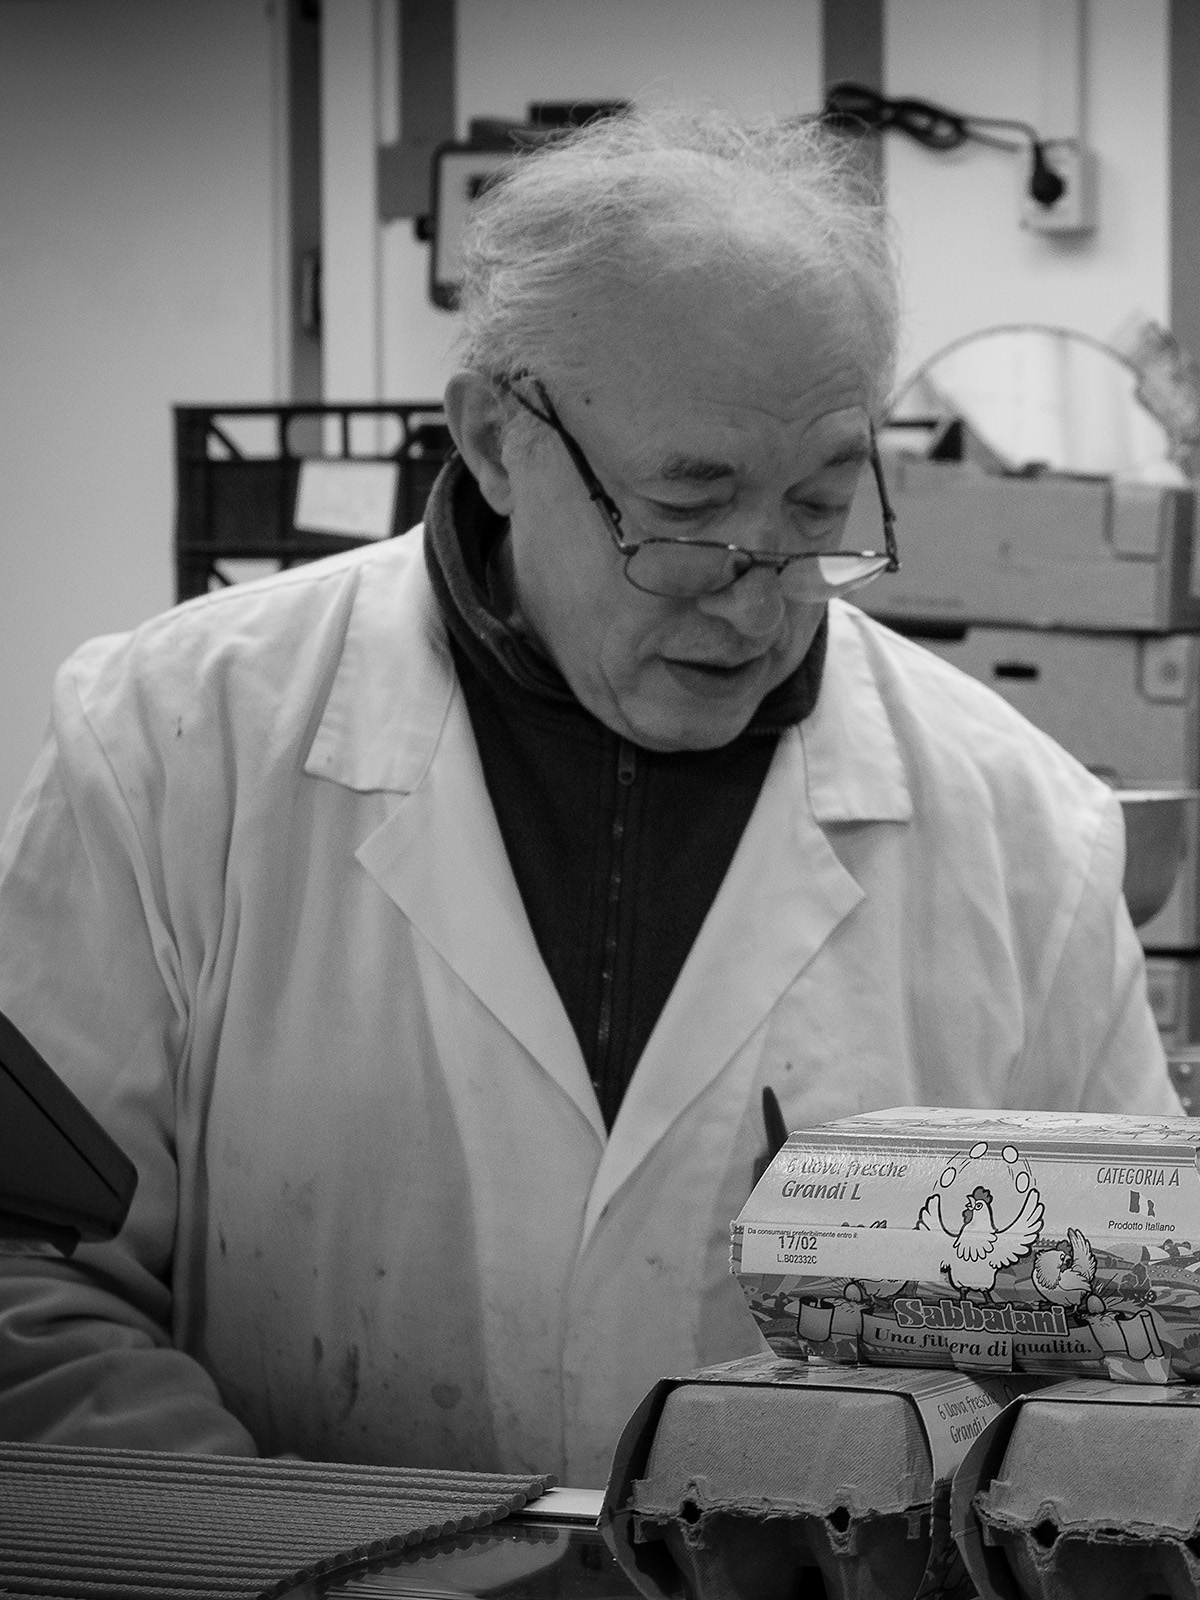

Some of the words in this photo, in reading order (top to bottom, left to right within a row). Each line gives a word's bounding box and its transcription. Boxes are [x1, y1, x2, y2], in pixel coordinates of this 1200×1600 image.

[786, 1158, 796, 1174] 6
[845, 1160, 908, 1178] fresche
[1096, 1167, 1164, 1186] CATEGORIA
[1168, 1168, 1180, 1187] A
[781, 1180, 849, 1200] Grandi
[851, 1183, 862, 1200] L
[747, 1227, 757, 1235] Da
[757, 1228, 792, 1237] consumarsi
[1108, 1220, 1143, 1231] Prodotto
[1145, 1222, 1176, 1232] Italiano
[778, 1235, 818, 1251] 17/02
[893, 1298, 1069, 1337] Sabbatani
[874, 1326, 917, 1345] Una
[919, 1333, 983, 1357] filiera
[987, 1341, 1009, 1358] di
[1015, 1338, 1092, 1356] qualità.
[937, 1404, 947, 1420] 6
[943, 1400, 969, 1418] Uova
[949, 1416, 983, 1444] Grandi
